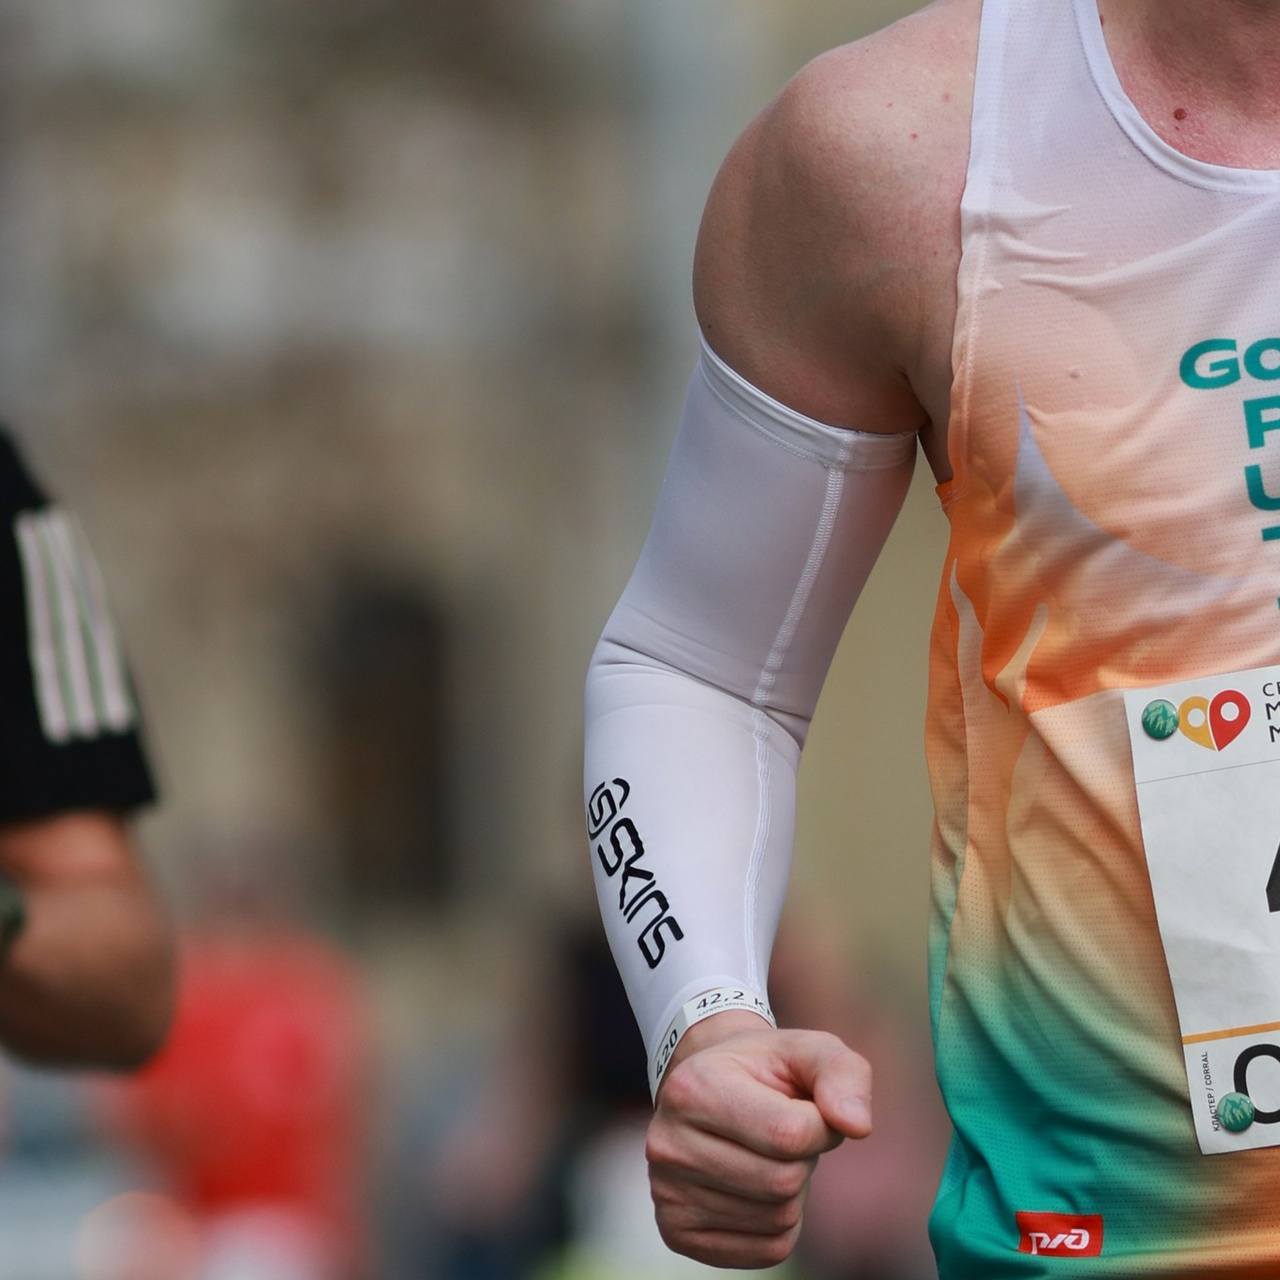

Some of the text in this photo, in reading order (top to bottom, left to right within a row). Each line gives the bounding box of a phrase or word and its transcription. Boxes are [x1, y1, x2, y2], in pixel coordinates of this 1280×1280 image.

[597, 817, 685, 970] SKINS
[696, 990, 745, 1011] 42,2
[656, 1028, 679, 1080] 420
[1201, 1051, 1213, 1086] CORRAL
